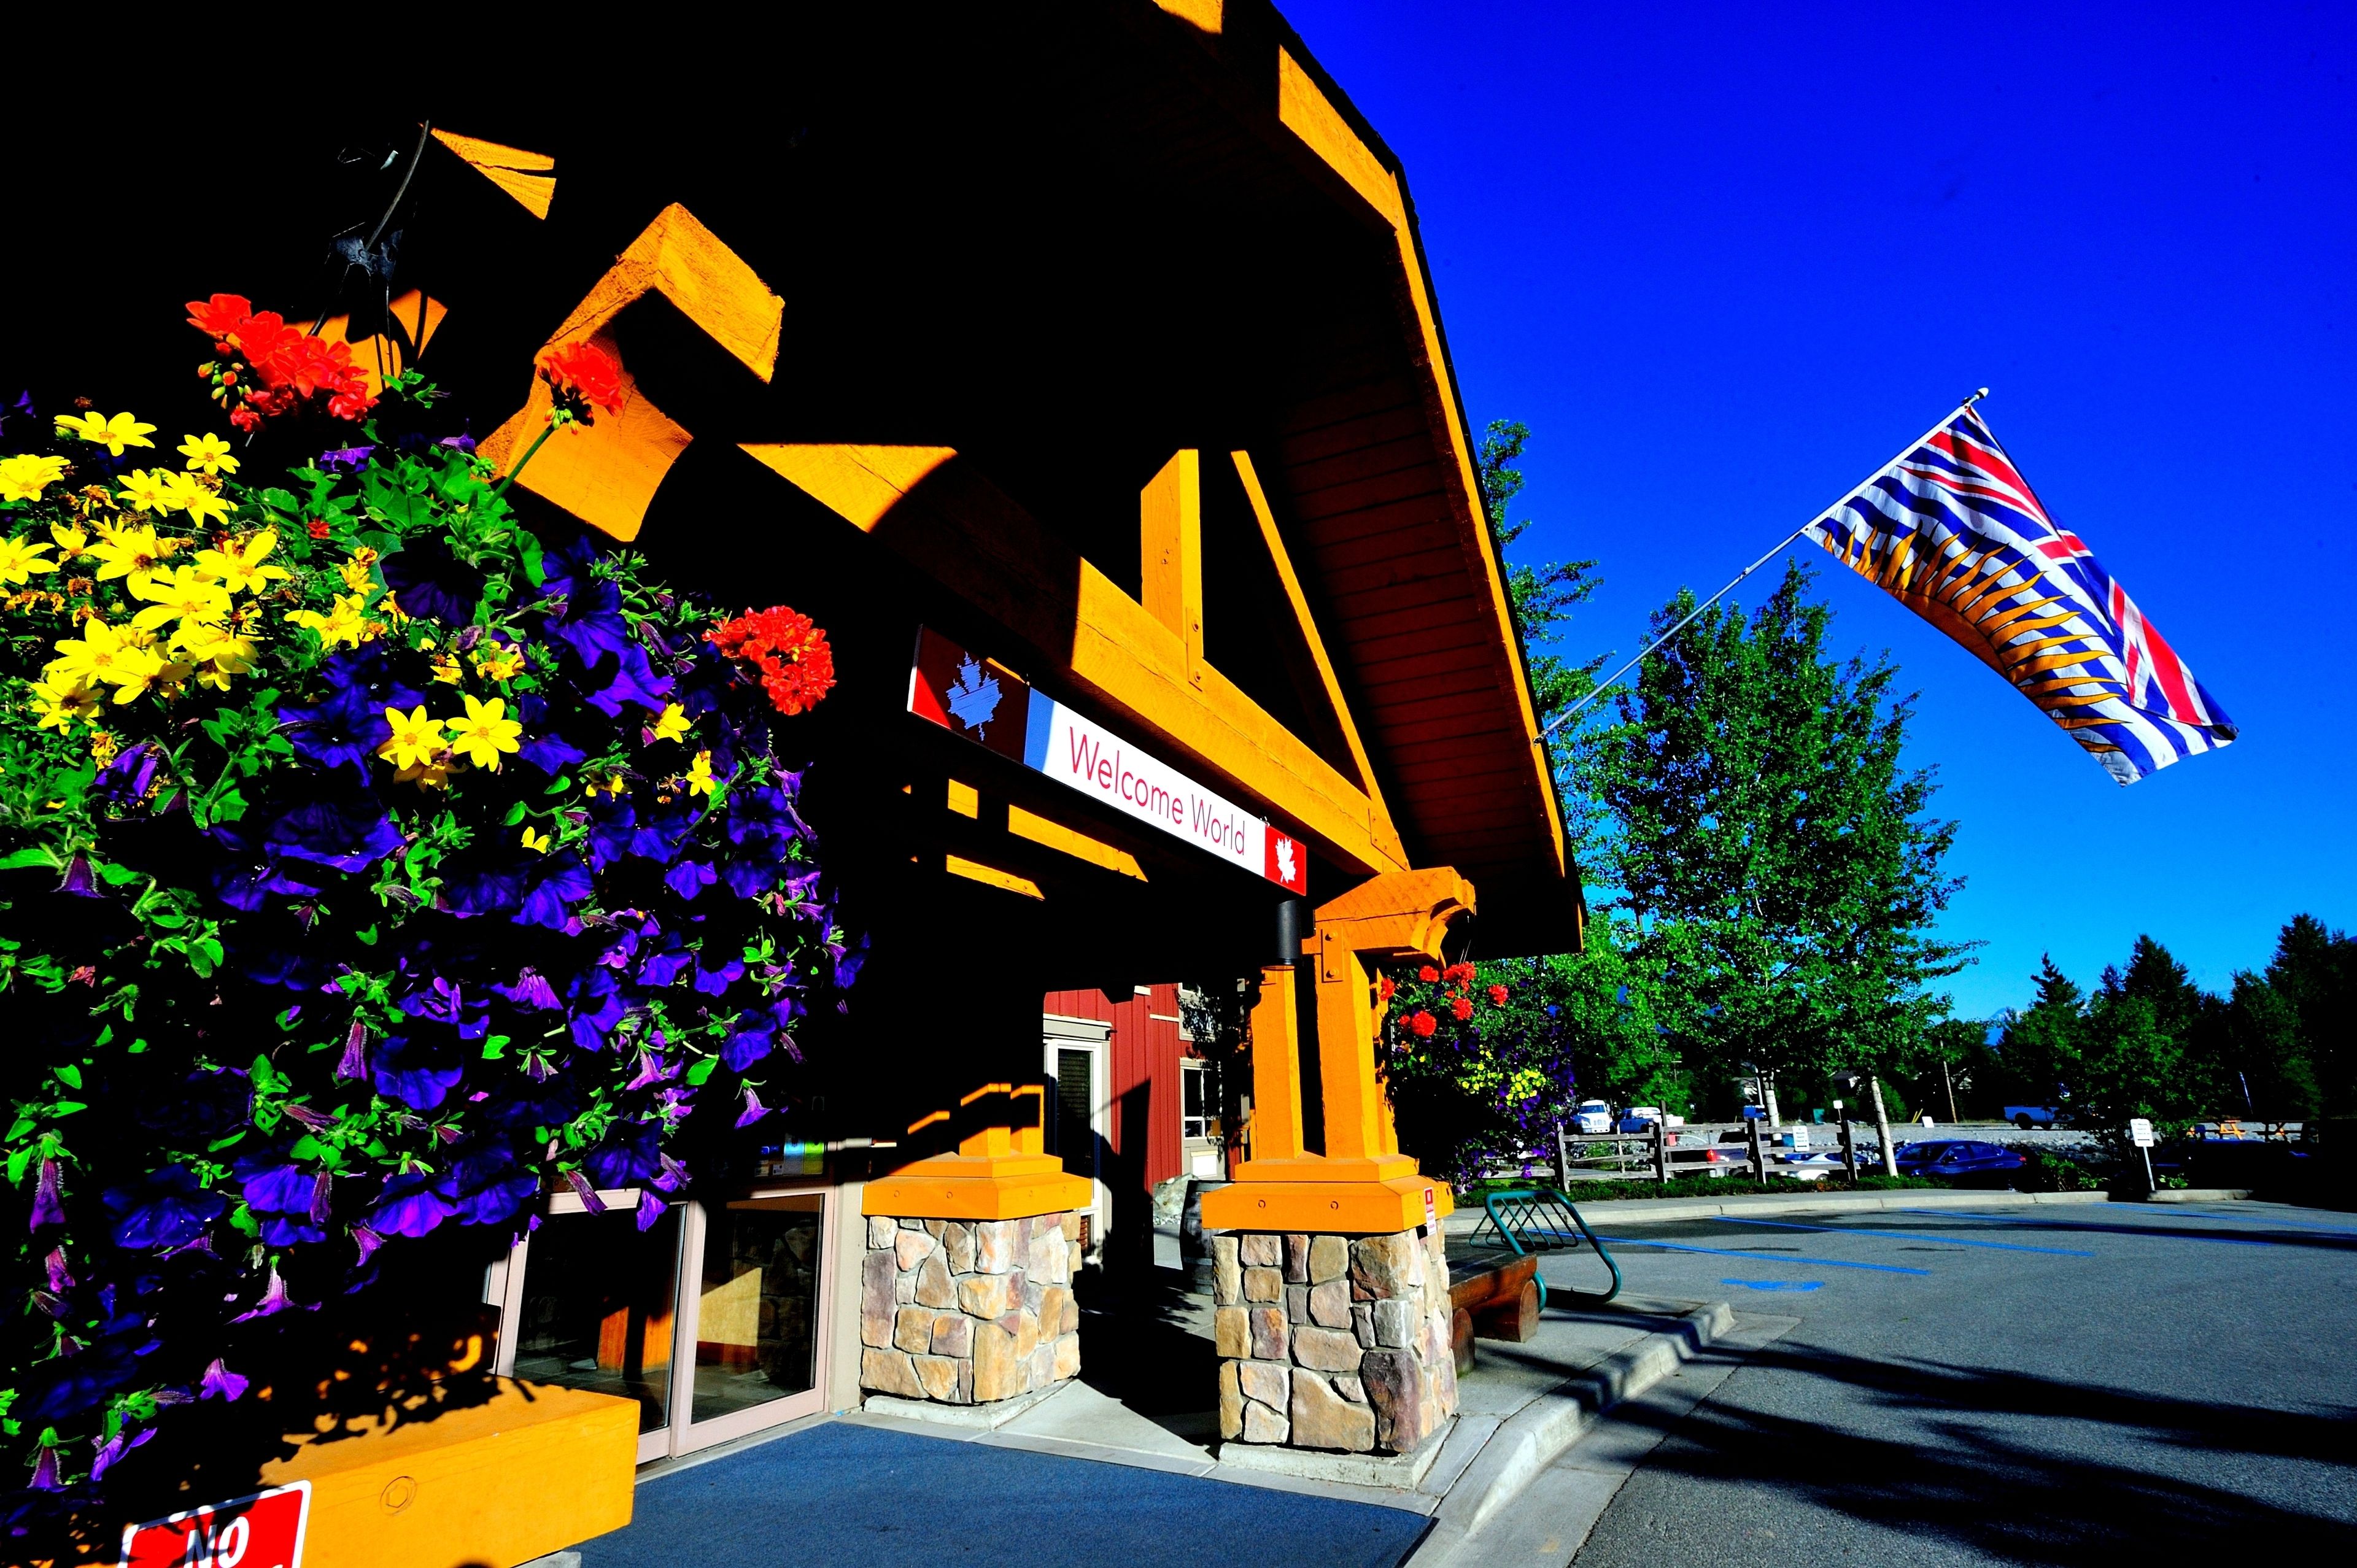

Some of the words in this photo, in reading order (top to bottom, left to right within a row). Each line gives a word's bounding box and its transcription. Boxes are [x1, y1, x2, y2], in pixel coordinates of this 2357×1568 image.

[1070, 726, 1183, 825] Welcome
[1191, 794, 1245, 856] World
[183, 1516, 250, 1568] NO
